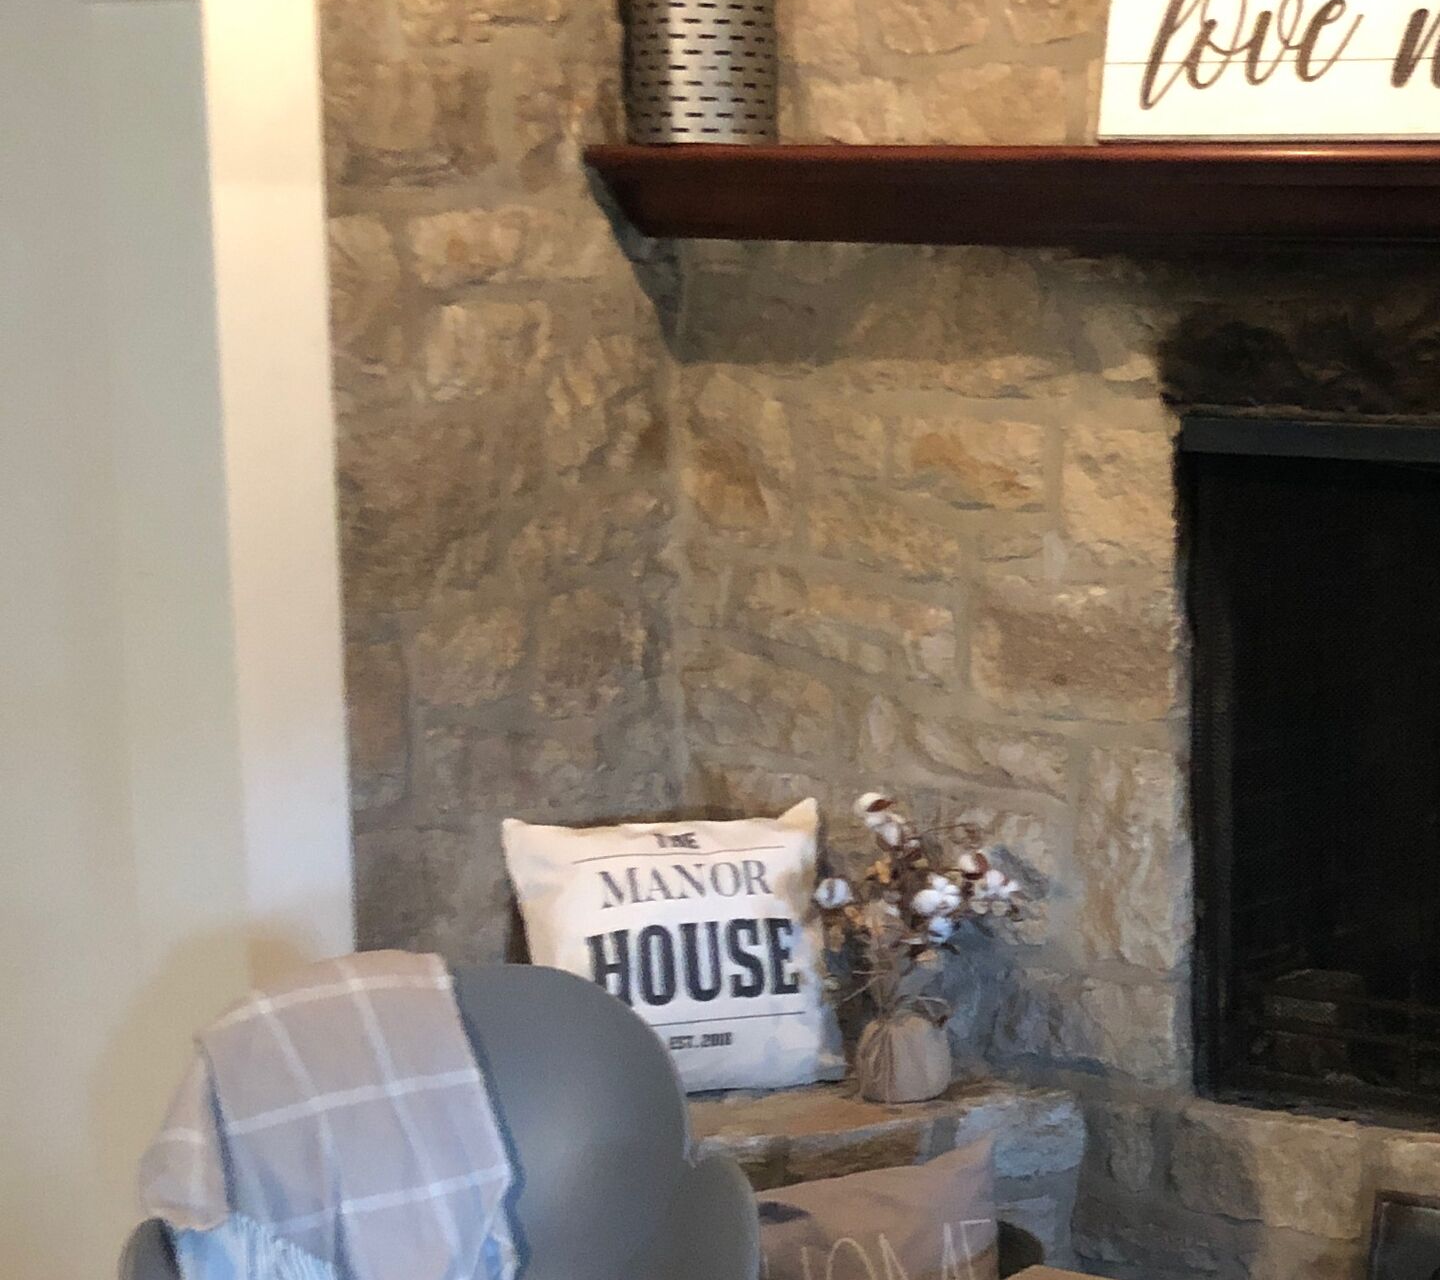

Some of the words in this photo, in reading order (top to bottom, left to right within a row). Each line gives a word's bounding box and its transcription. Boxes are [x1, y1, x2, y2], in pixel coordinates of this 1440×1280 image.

[653, 831, 701, 850] THE
[598, 859, 774, 909] MANOR
[584, 917, 800, 1007] HOUSE
